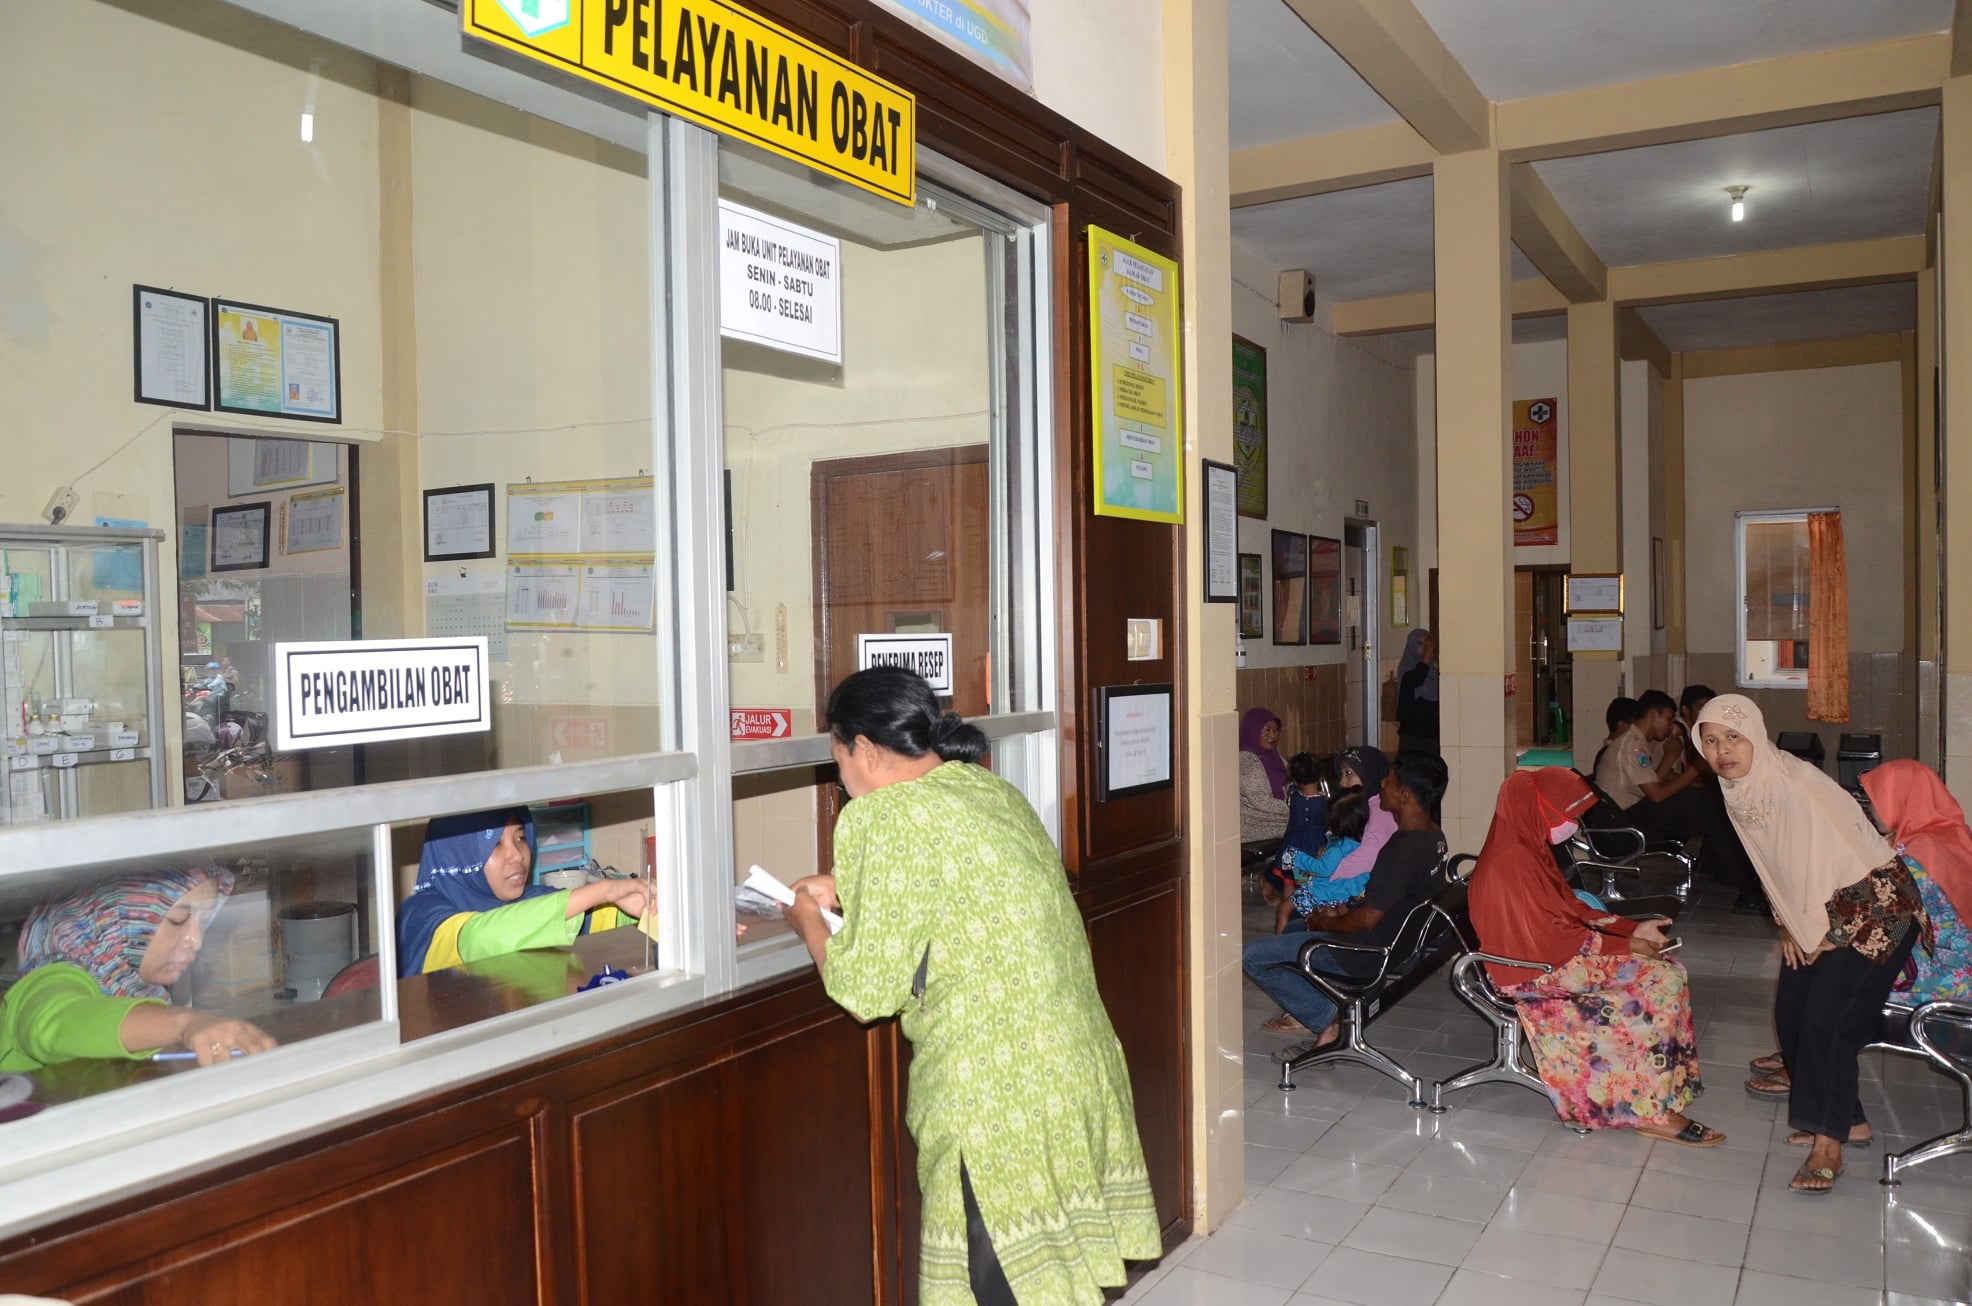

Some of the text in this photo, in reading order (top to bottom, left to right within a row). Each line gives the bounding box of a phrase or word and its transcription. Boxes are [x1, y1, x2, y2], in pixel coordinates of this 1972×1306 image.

[955, 16, 965, 31] di
[967, 20, 988, 44] UGD
[604, 0, 900, 175] PELAYANAN OBAT
[726, 228, 830, 279] JAM BUKA UNIT PELAYANAN OBAT
[747, 264, 776, 286] SENIN
[783, 275, 813, 297] SABTU
[749, 289, 772, 312] 08.00
[778, 298, 813, 324] SELESAI
[918, 651, 944, 679] RESEP
[301, 664, 471, 716] PENGAMBILAN OBAT
[745, 714, 772, 725] JALUR
[745, 725, 772, 734] EVAKUASI
